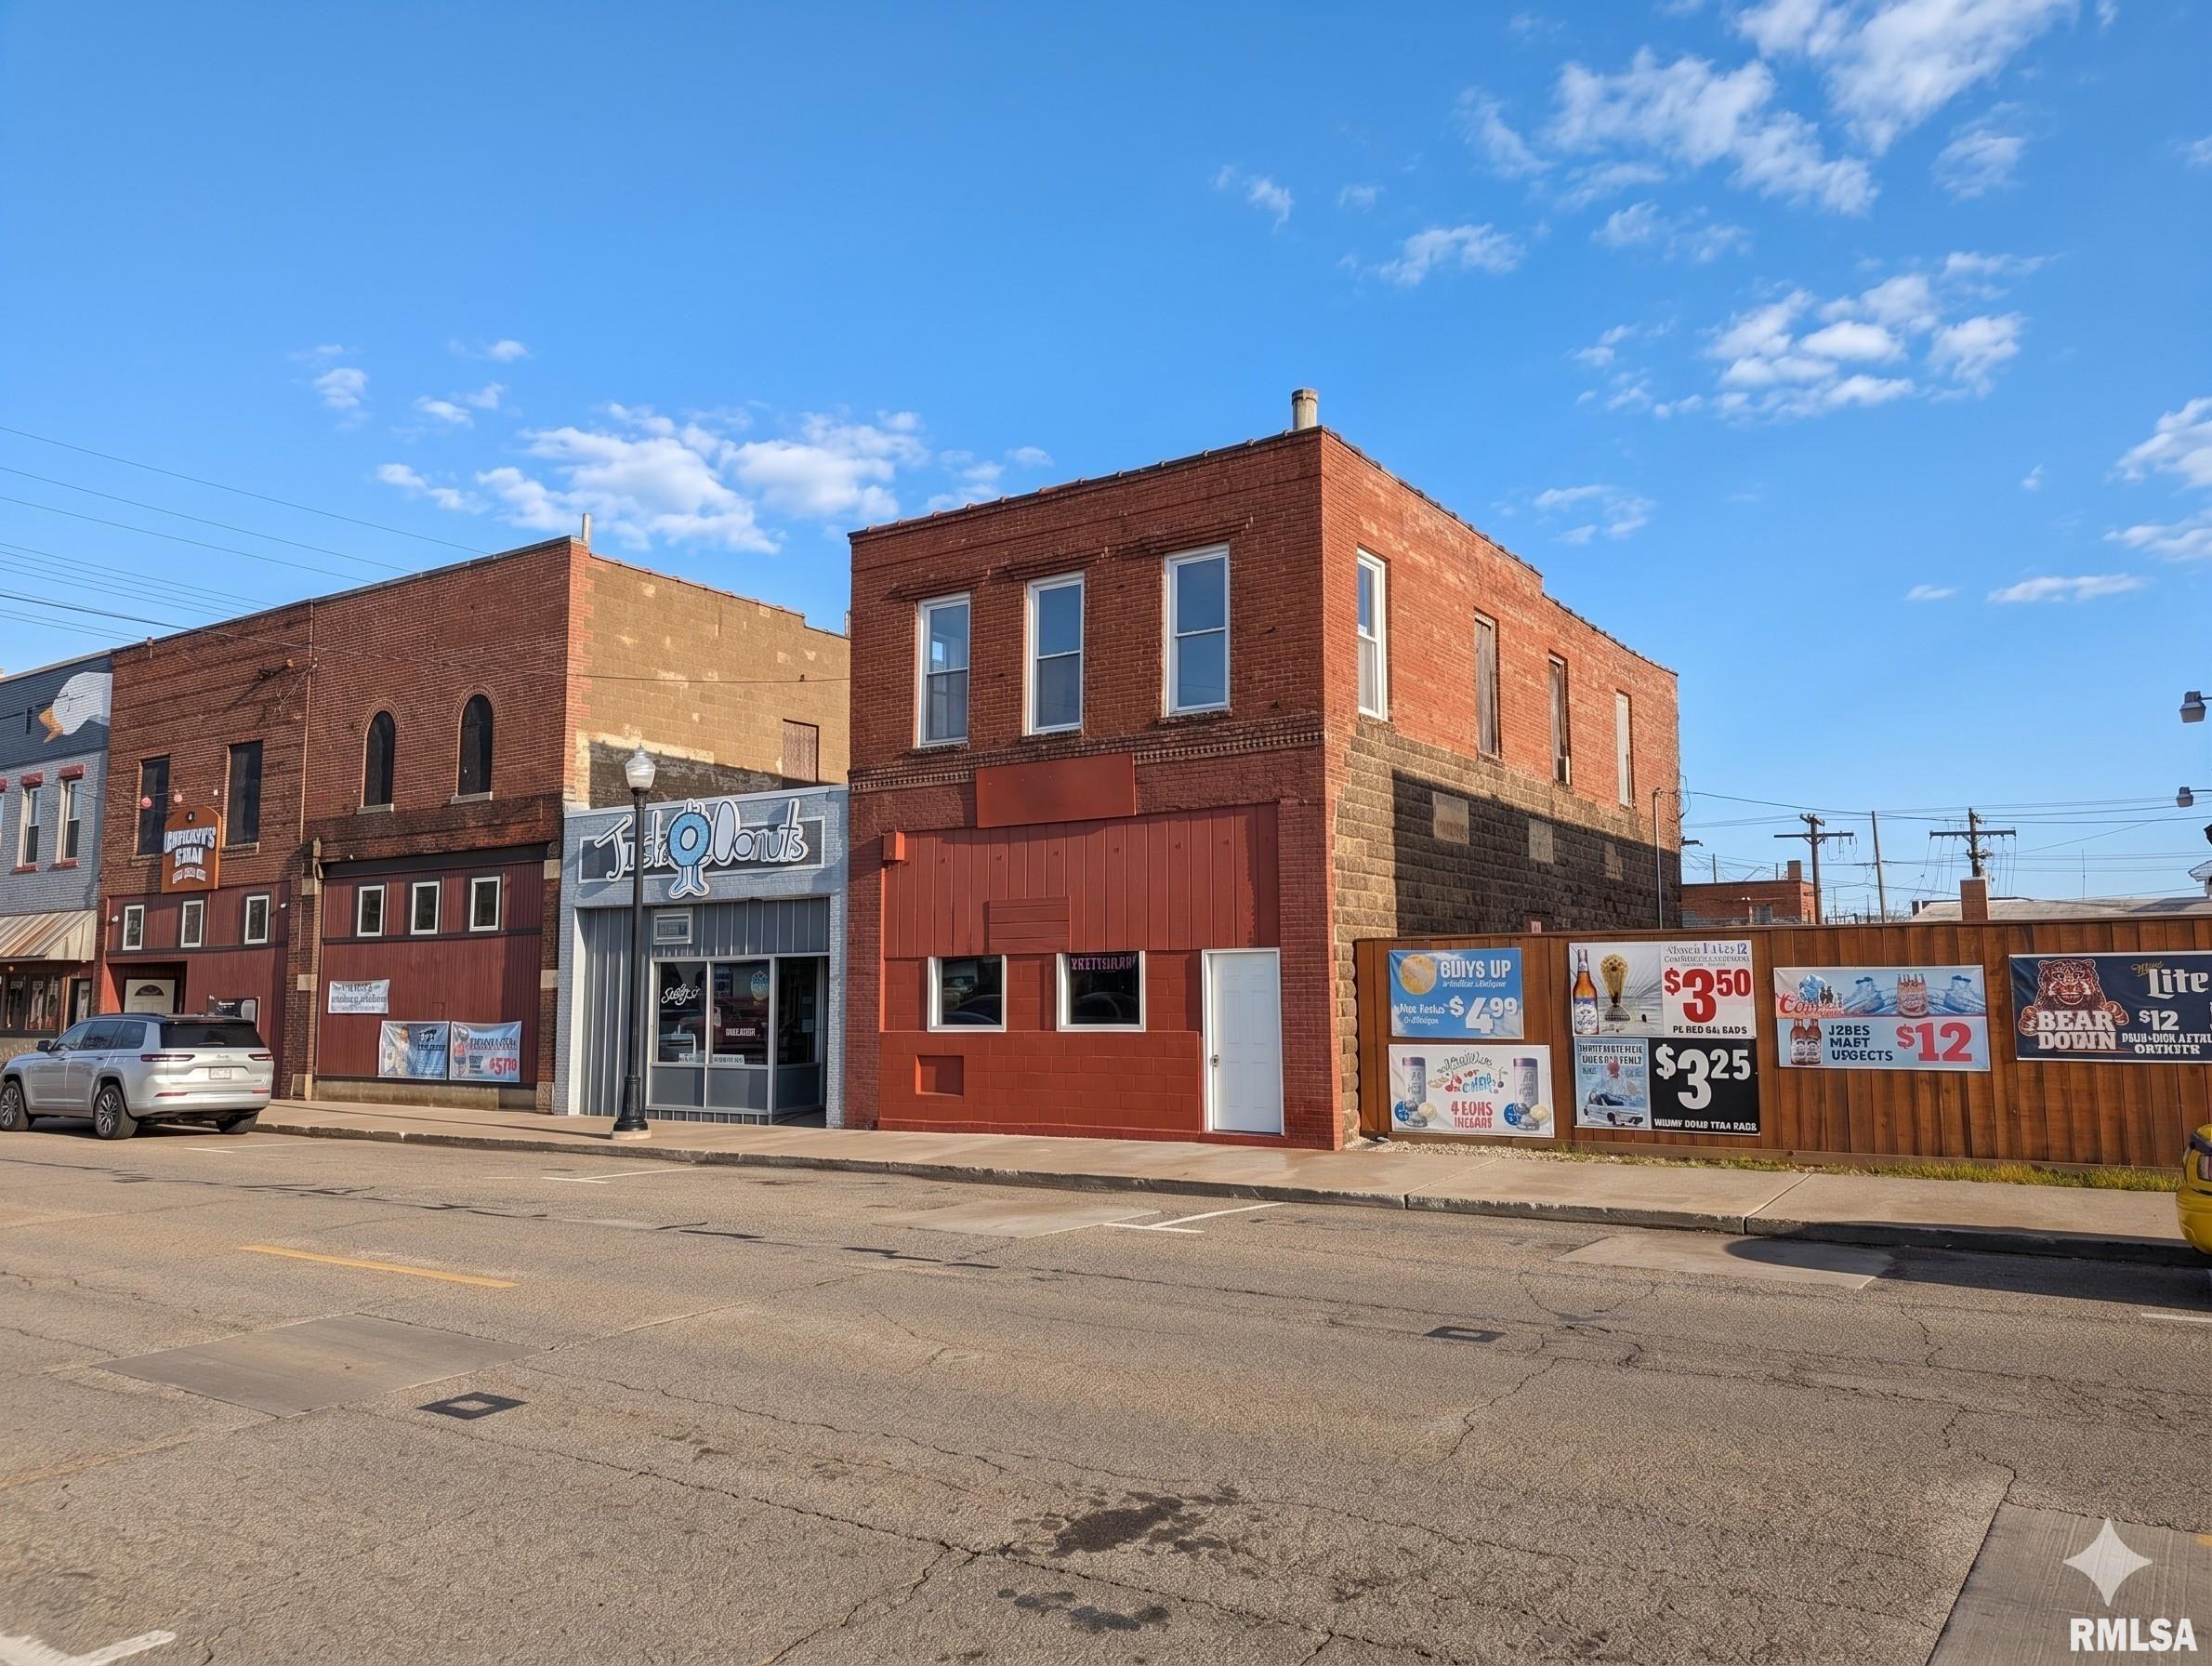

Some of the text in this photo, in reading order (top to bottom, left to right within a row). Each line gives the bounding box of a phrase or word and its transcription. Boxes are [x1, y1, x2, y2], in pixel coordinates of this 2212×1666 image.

[1490, 959, 1511, 979] UP
[2147, 969, 2209, 999] Lite
[2036, 1010, 2116, 1032] BEAR
[1896, 1023, 1972, 1062] $12
[1451, 1101, 1459, 1116] 4
